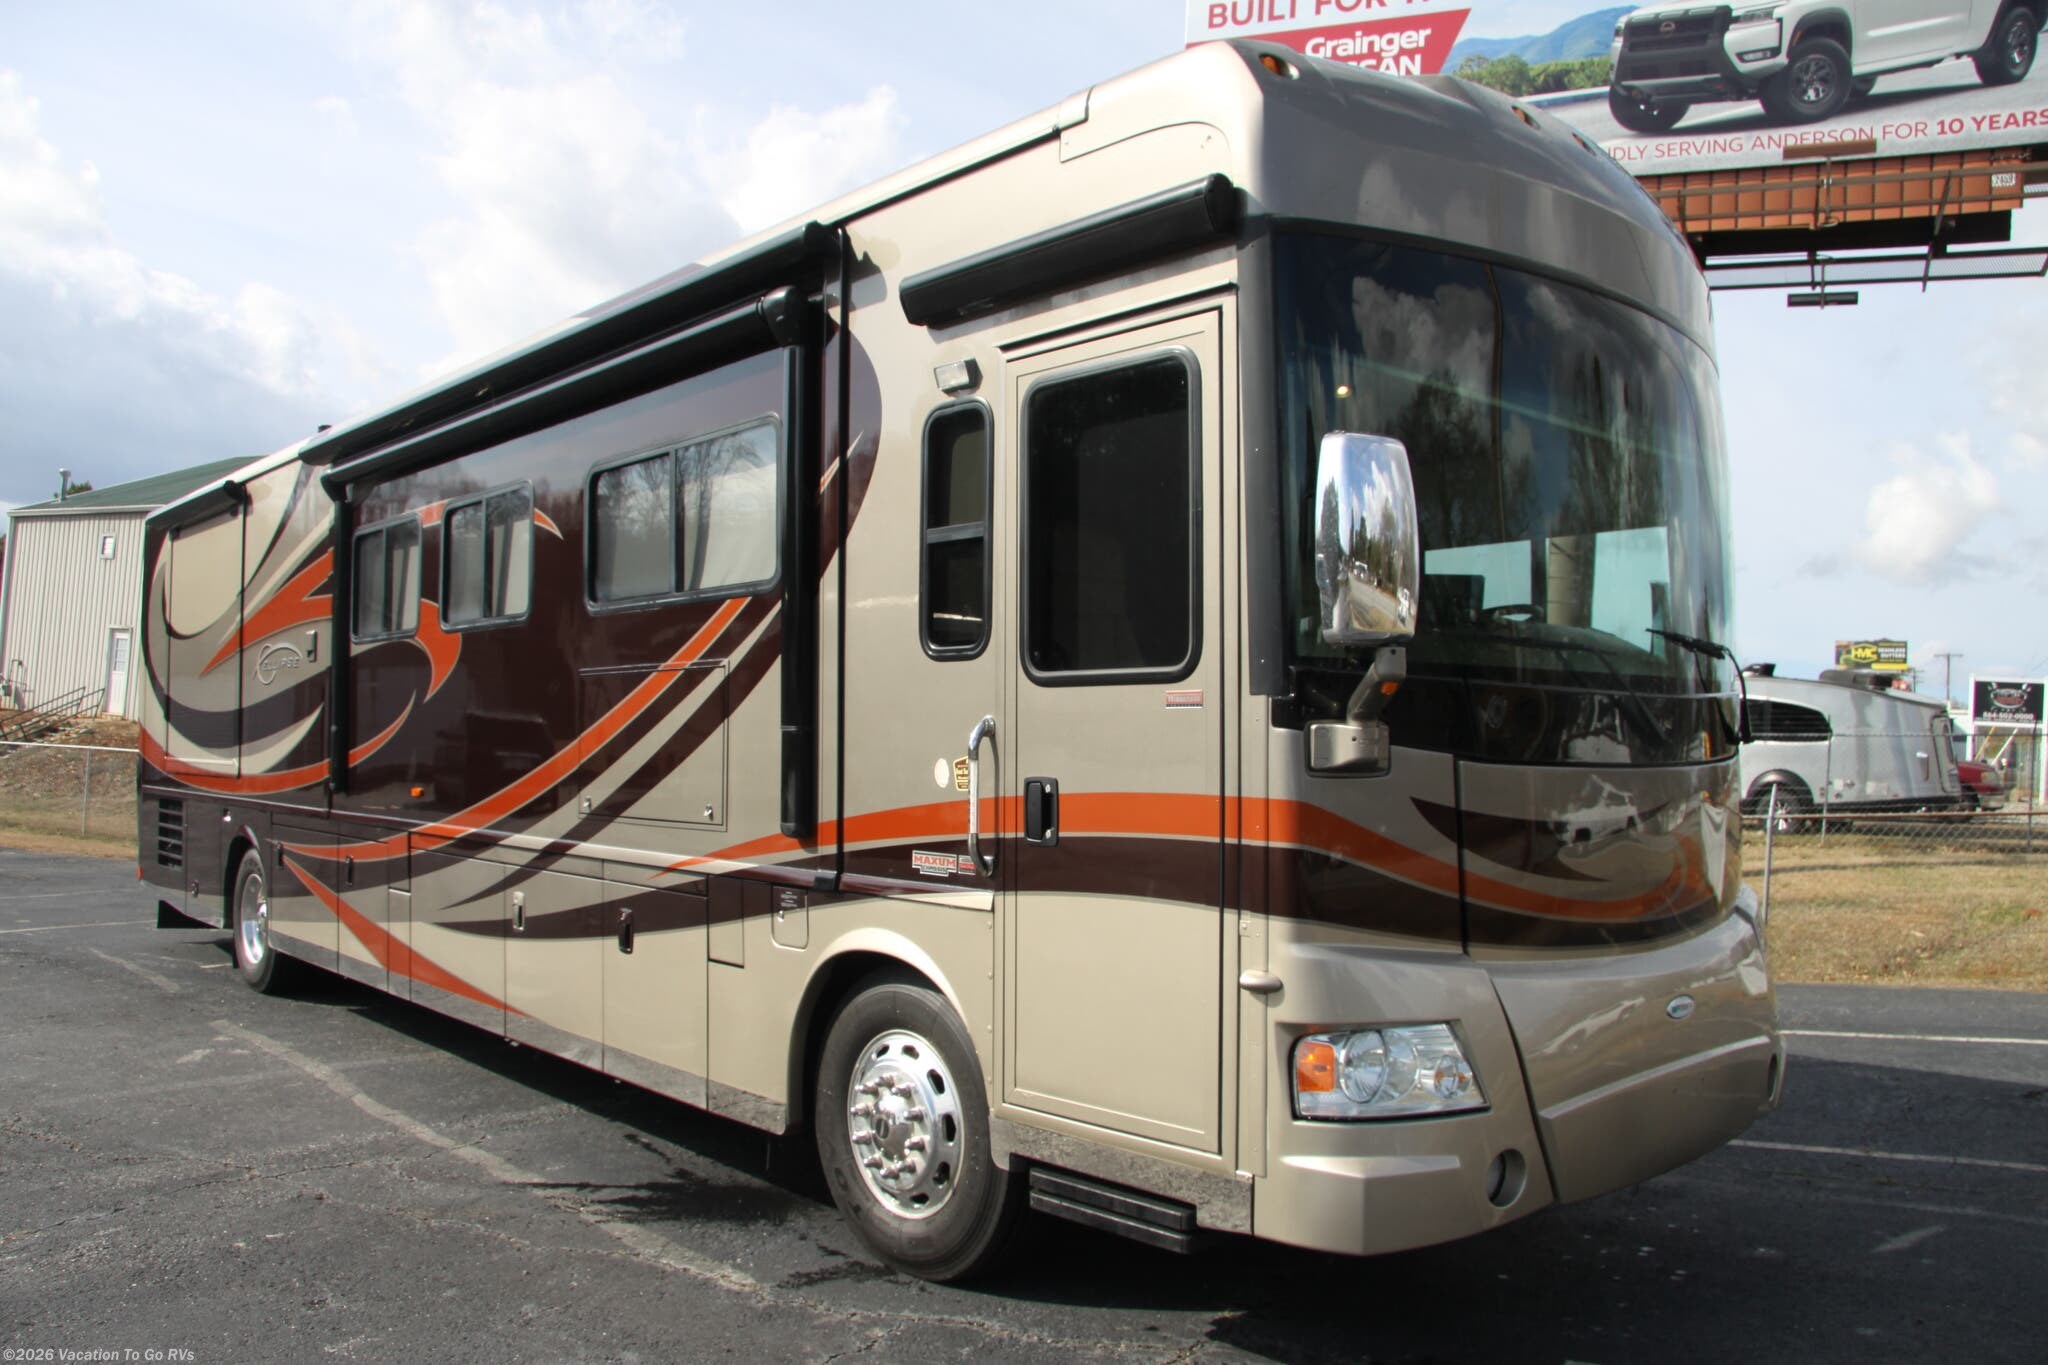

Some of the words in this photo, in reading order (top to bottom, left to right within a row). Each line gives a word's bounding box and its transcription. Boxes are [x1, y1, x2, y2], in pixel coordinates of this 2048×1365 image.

[1305, 28, 1432, 58] Grainger
[1654, 136, 1743, 159] SERVING
[1882, 121, 1928, 140] FOR
[1936, 118, 1964, 136] 10
[914, 855, 956, 868] MAXUM
